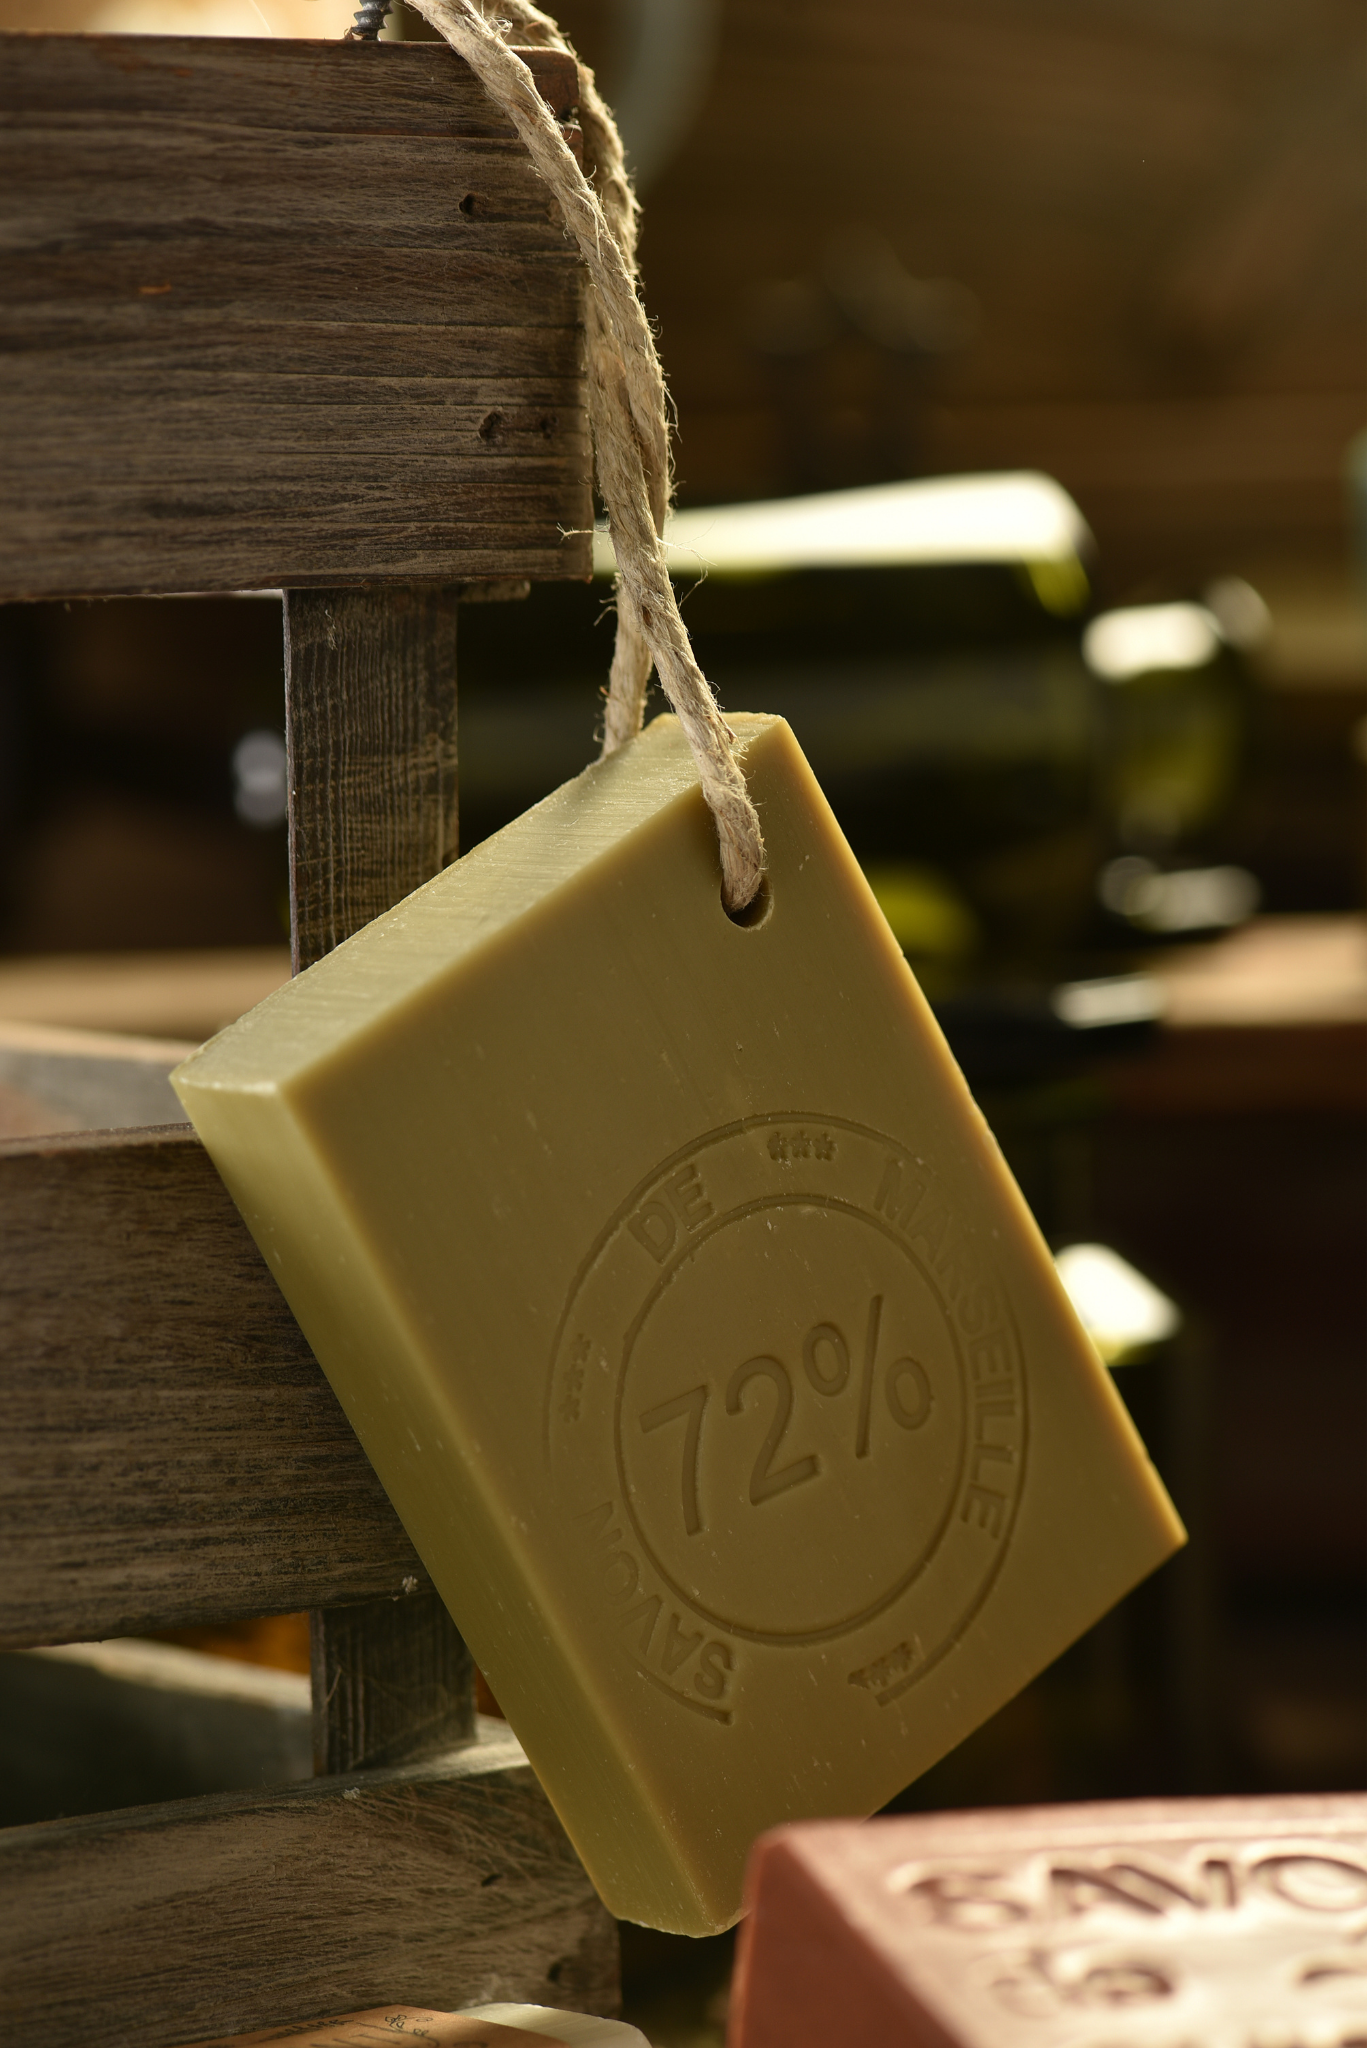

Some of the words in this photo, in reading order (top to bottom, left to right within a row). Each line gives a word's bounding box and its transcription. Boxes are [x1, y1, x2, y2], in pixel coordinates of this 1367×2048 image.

[627, 1163, 715, 1264] DE
[638, 1294, 933, 1537] 72%
[873, 1157, 1014, 1540] MARSEILLE
[572, 1501, 734, 1699] SAVON
